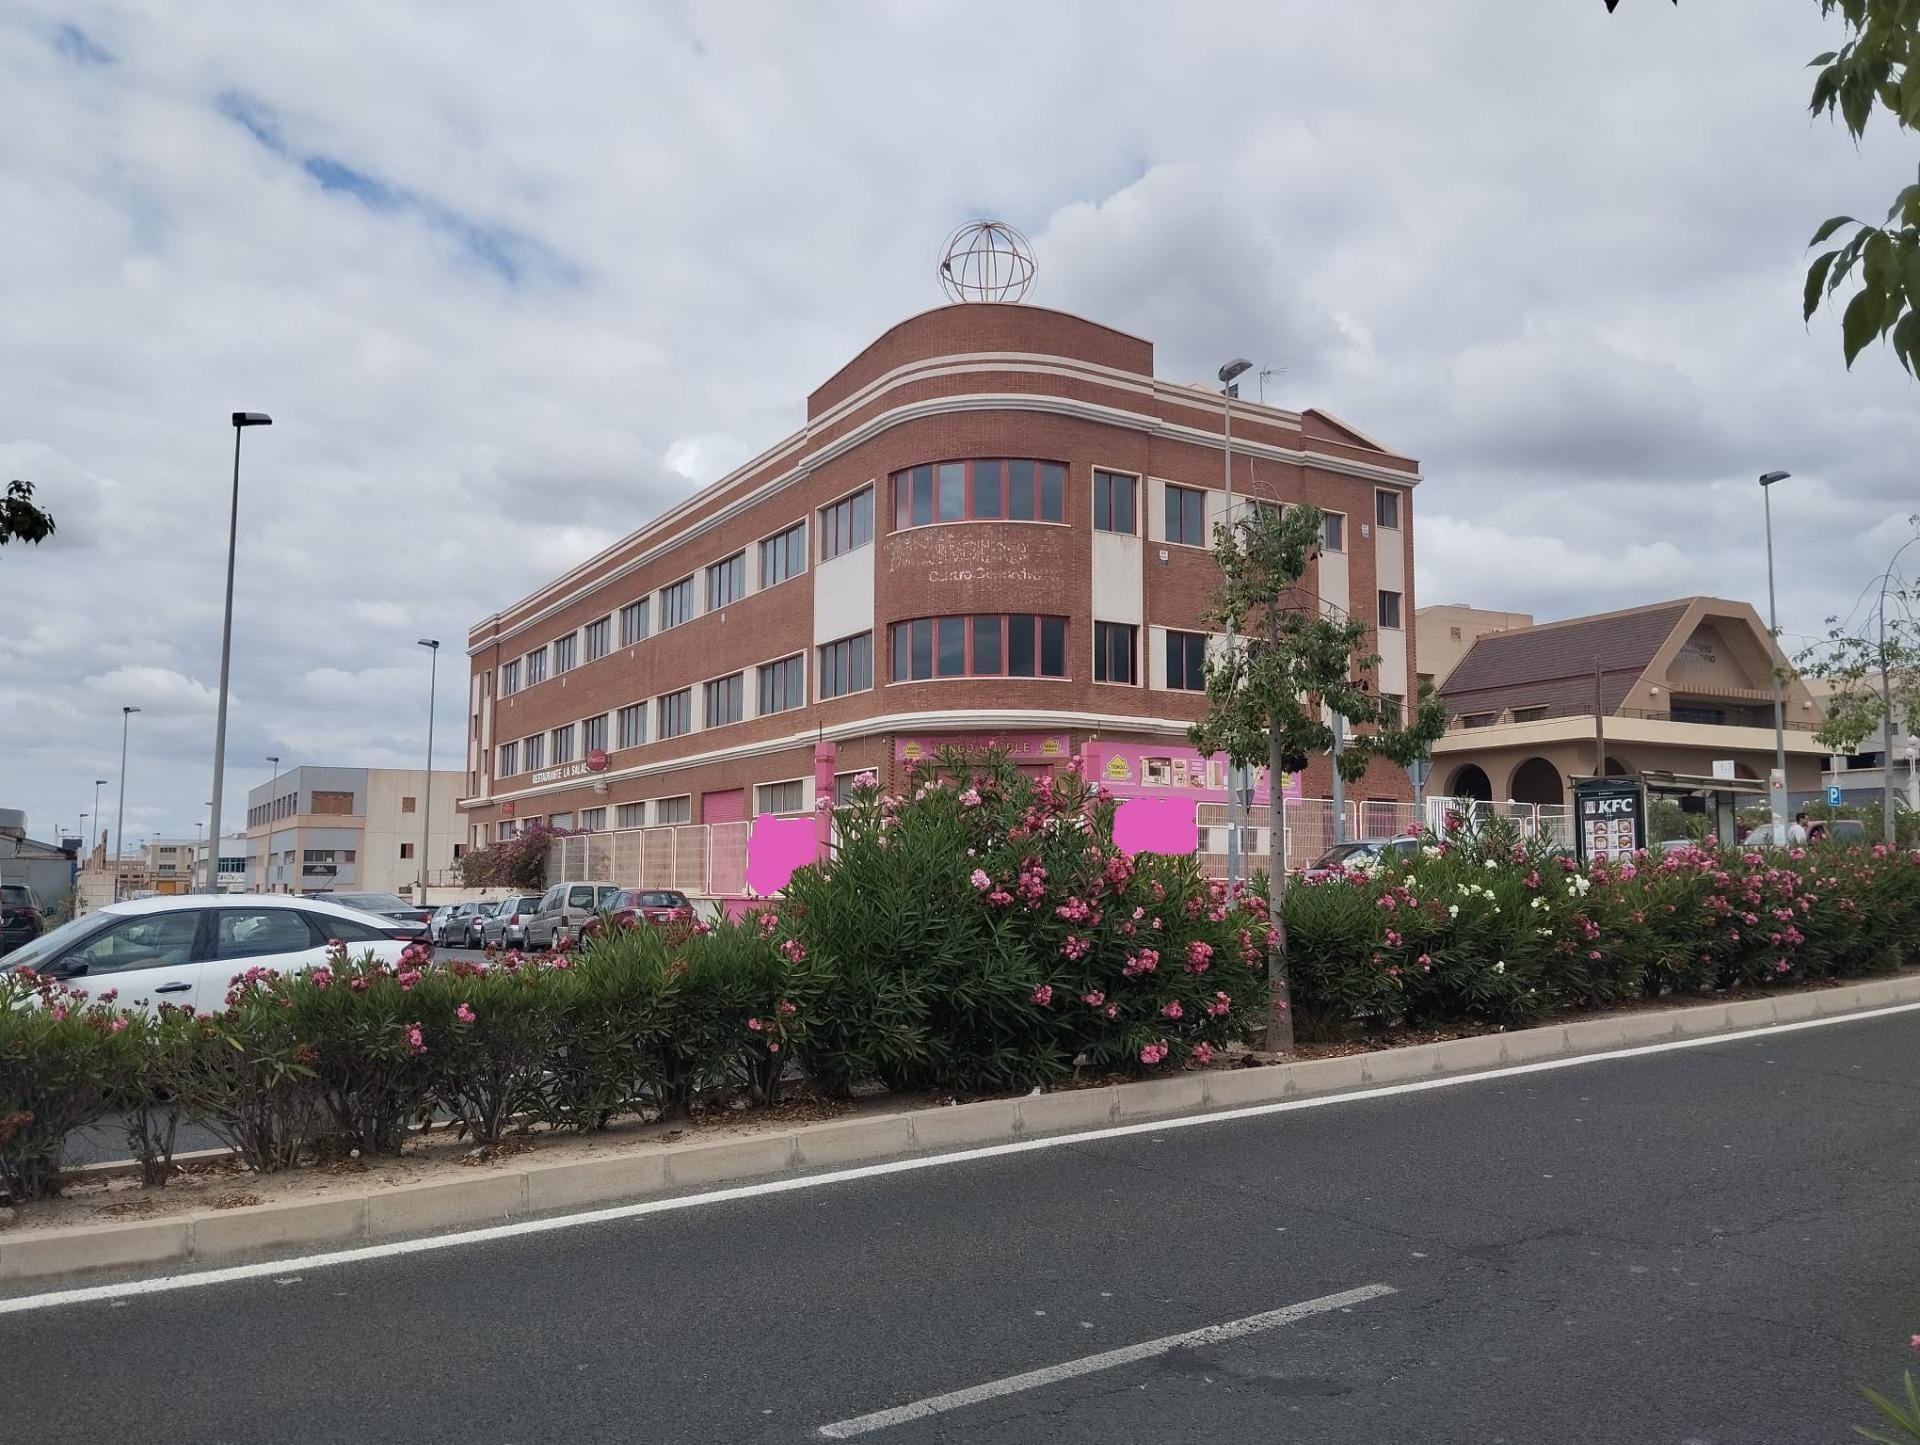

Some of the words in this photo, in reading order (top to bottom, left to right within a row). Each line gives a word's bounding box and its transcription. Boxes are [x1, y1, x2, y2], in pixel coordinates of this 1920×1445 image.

[563, 766, 570, 778] LA
[1830, 788, 1838, 802] P
[1598, 798, 1633, 814] KFC
